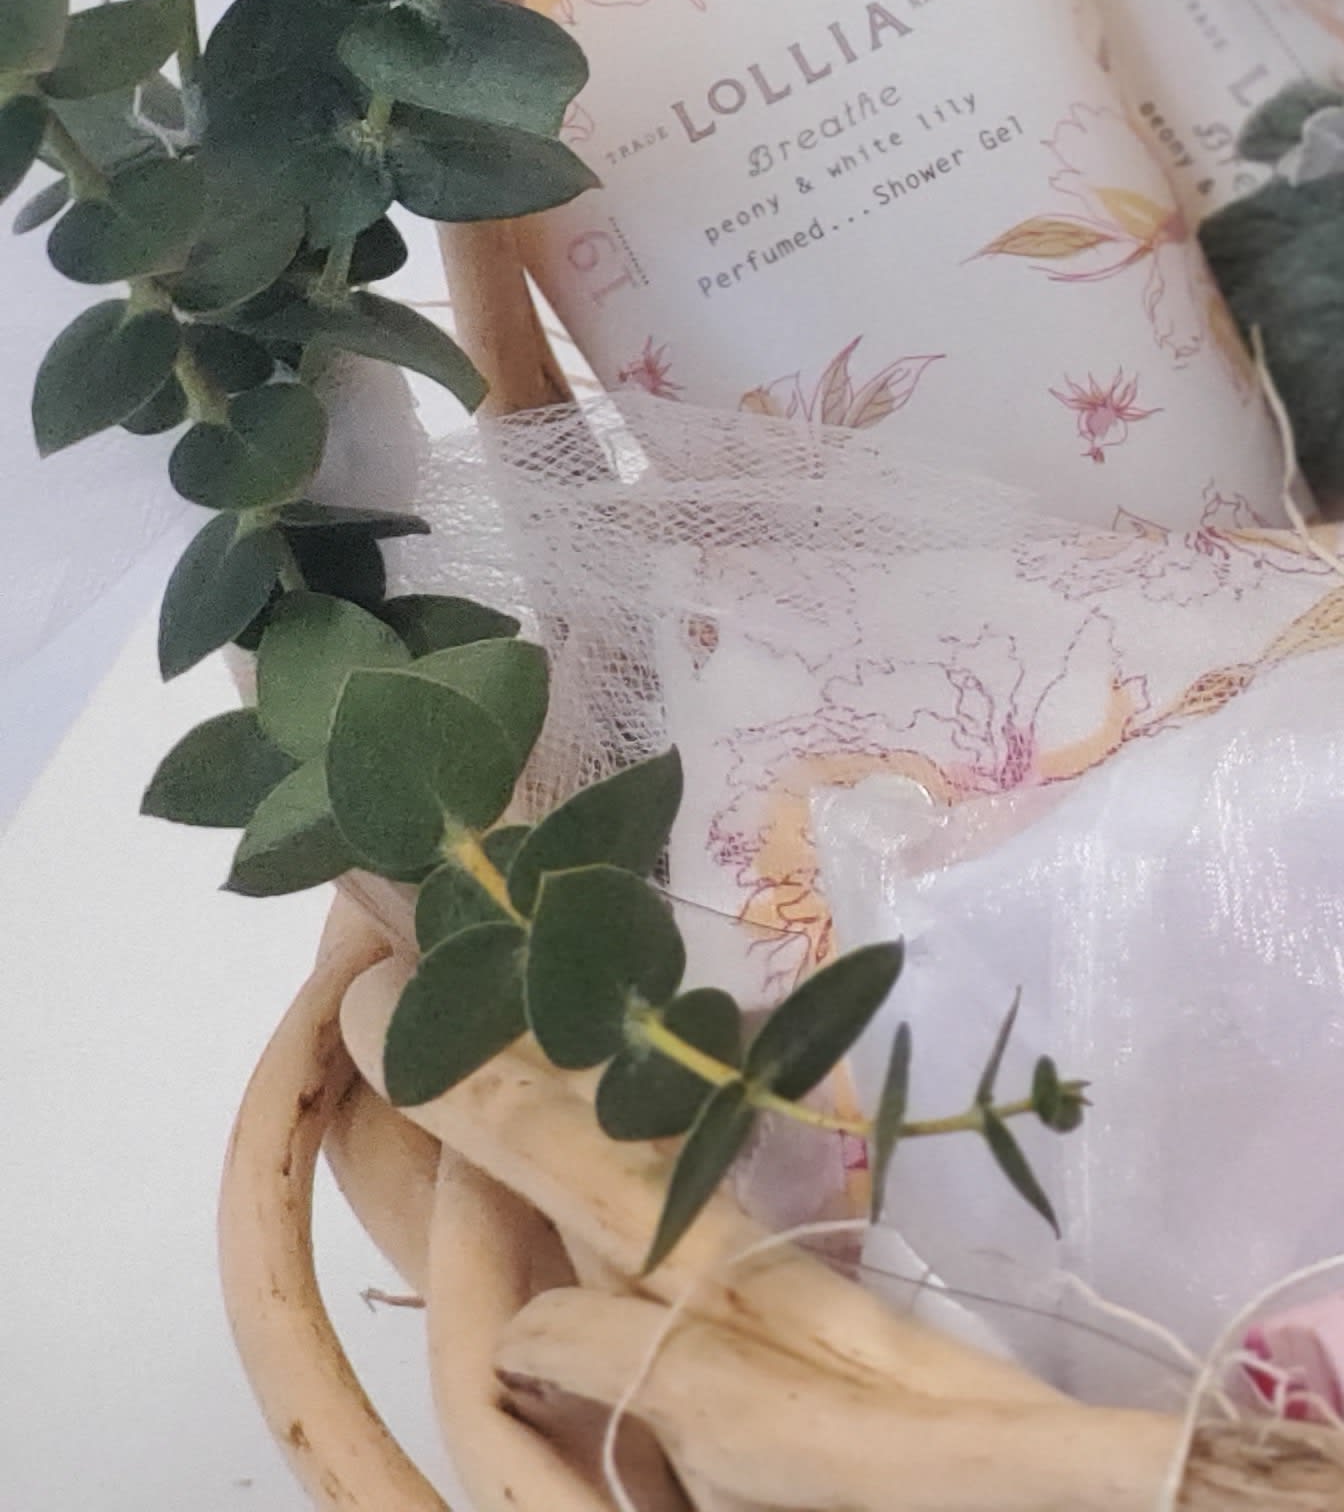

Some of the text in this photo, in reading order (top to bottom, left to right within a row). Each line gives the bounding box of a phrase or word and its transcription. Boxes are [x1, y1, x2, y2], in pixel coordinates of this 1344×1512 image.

[605, 126, 669, 167] TRADE
[671, 1, 913, 144] LOLLIA
[747, 84, 902, 178] Breathe
[978, 114, 1025, 151] Gel
[704, 92, 977, 246] peony & white lily
